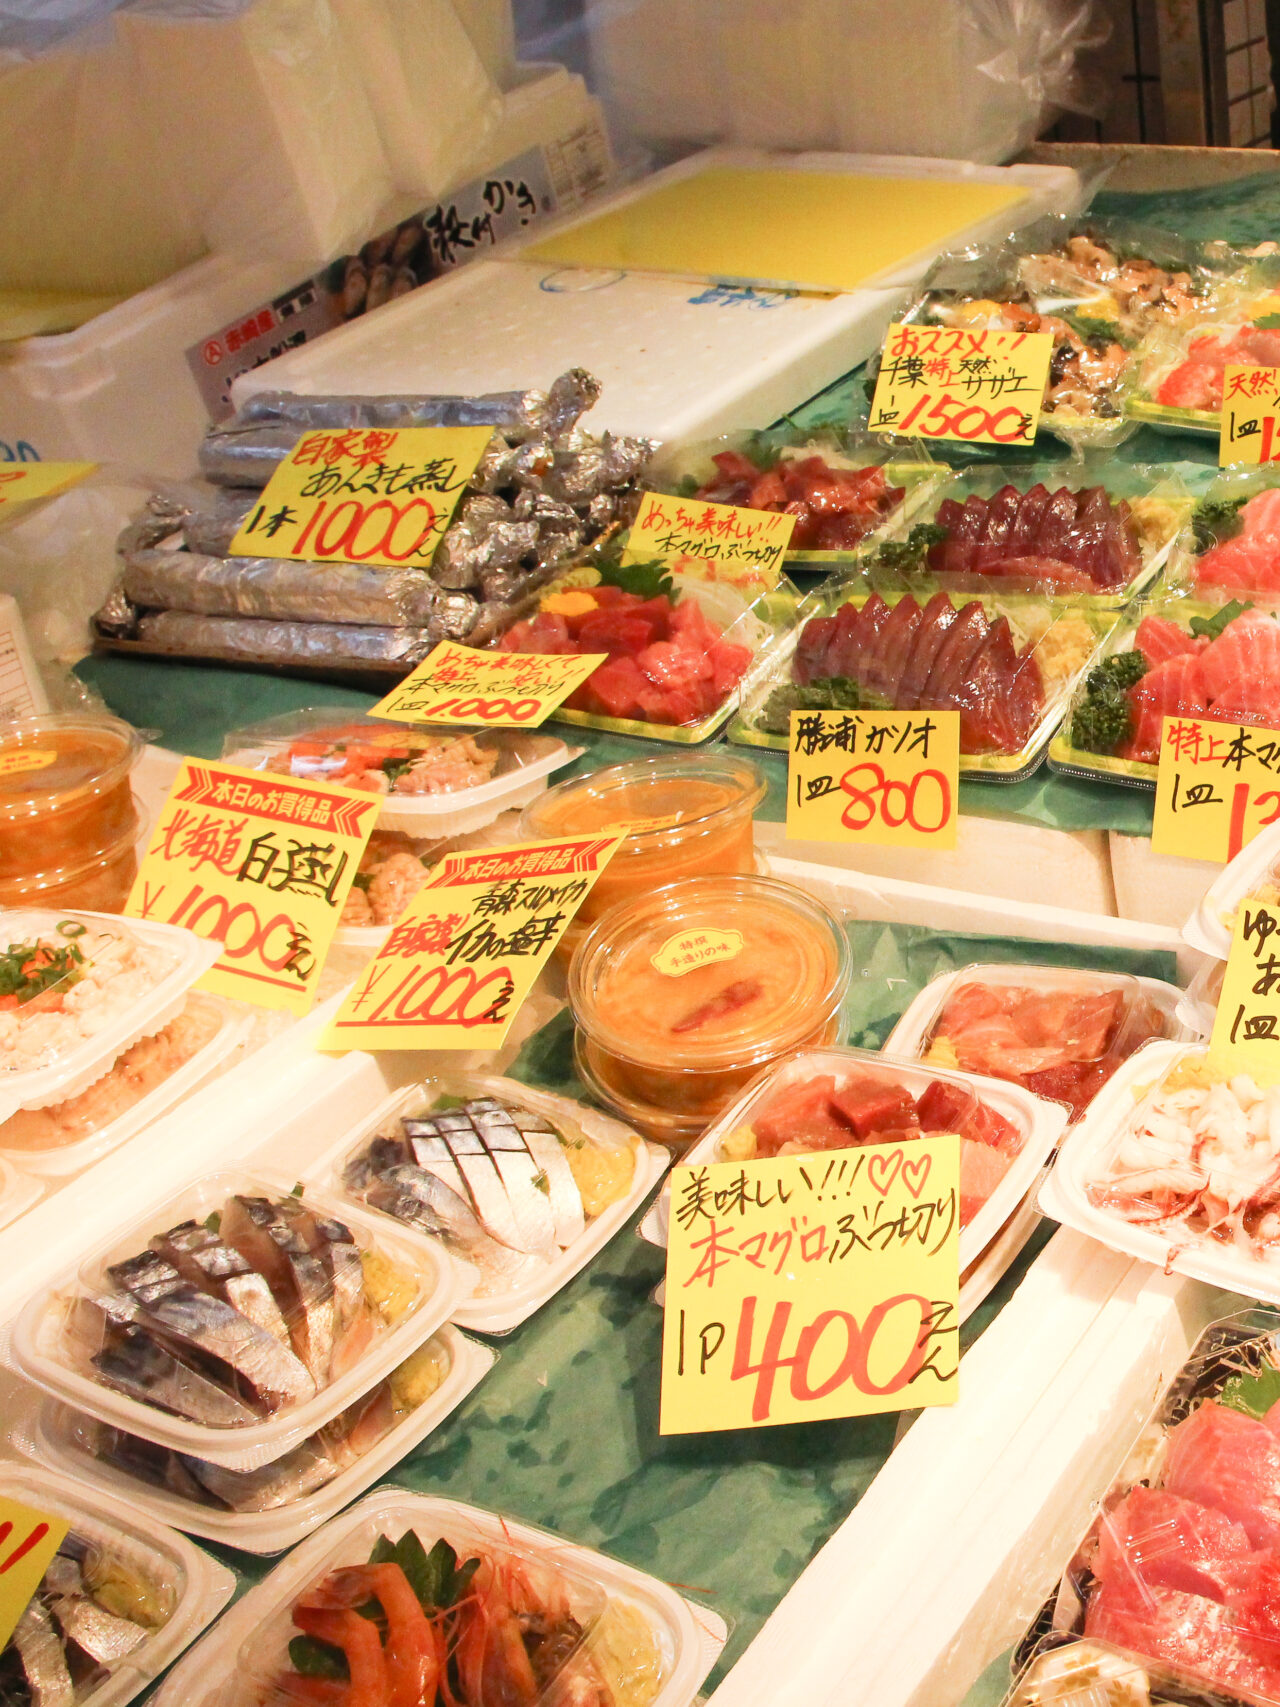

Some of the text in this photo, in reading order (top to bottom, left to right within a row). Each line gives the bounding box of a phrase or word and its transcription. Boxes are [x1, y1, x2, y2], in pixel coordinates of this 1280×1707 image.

[898, 393, 1028, 443] 1500
[1229, 411, 1262, 443] 1皿
[292, 428, 400, 467] 自家製
[245, 505, 298, 539] 1本
[291, 497, 436, 561] 1000
[211, 778, 333, 826] 本日のお買得品
[796, 762, 952, 834] 1皿 800
[1171, 773, 1224, 813] 1皿
[460, 847, 577, 882] 本日のお買得品
[1229, 1004, 1280, 1045] 1皿
[729, 1293, 934, 1423] 400
